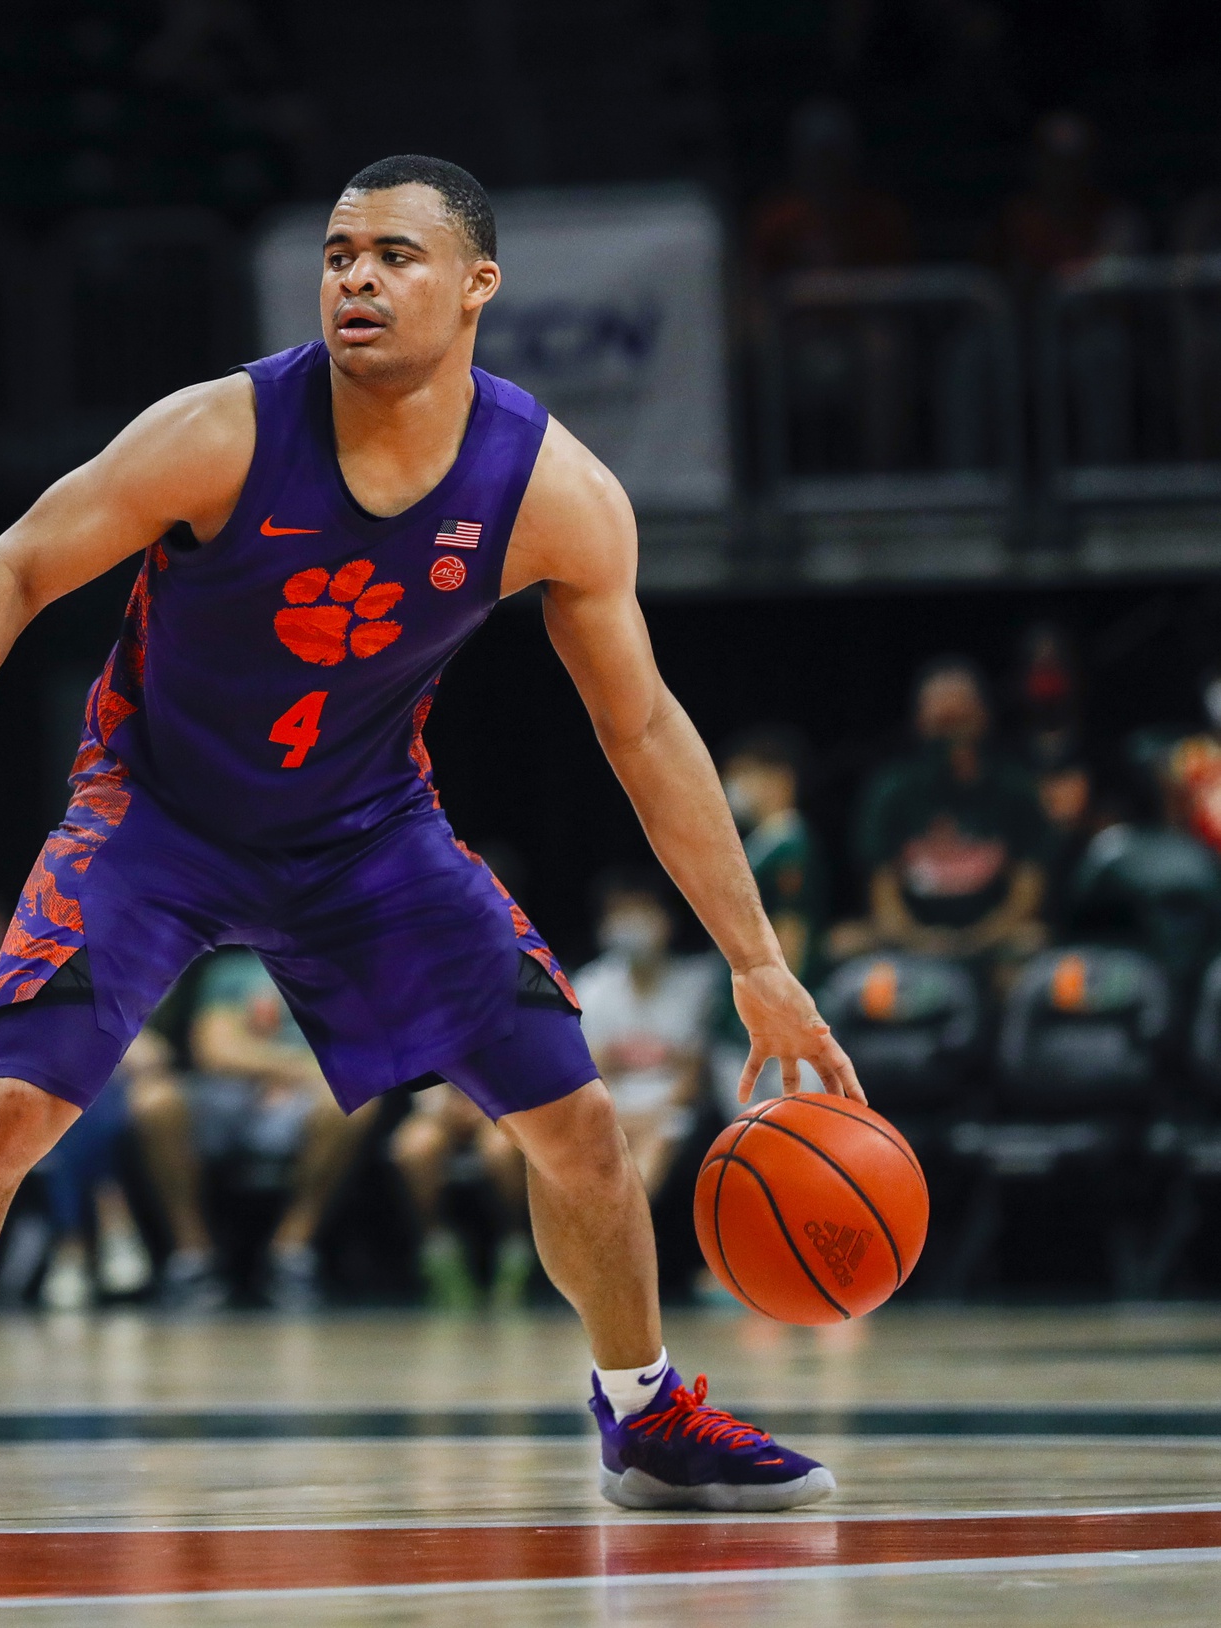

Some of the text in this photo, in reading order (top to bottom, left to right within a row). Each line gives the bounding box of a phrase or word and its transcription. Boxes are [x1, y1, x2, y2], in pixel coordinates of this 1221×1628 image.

[435, 567, 464, 579] ACC
[268, 691, 329, 768] 4
[803, 1220, 854, 1287] adidas
